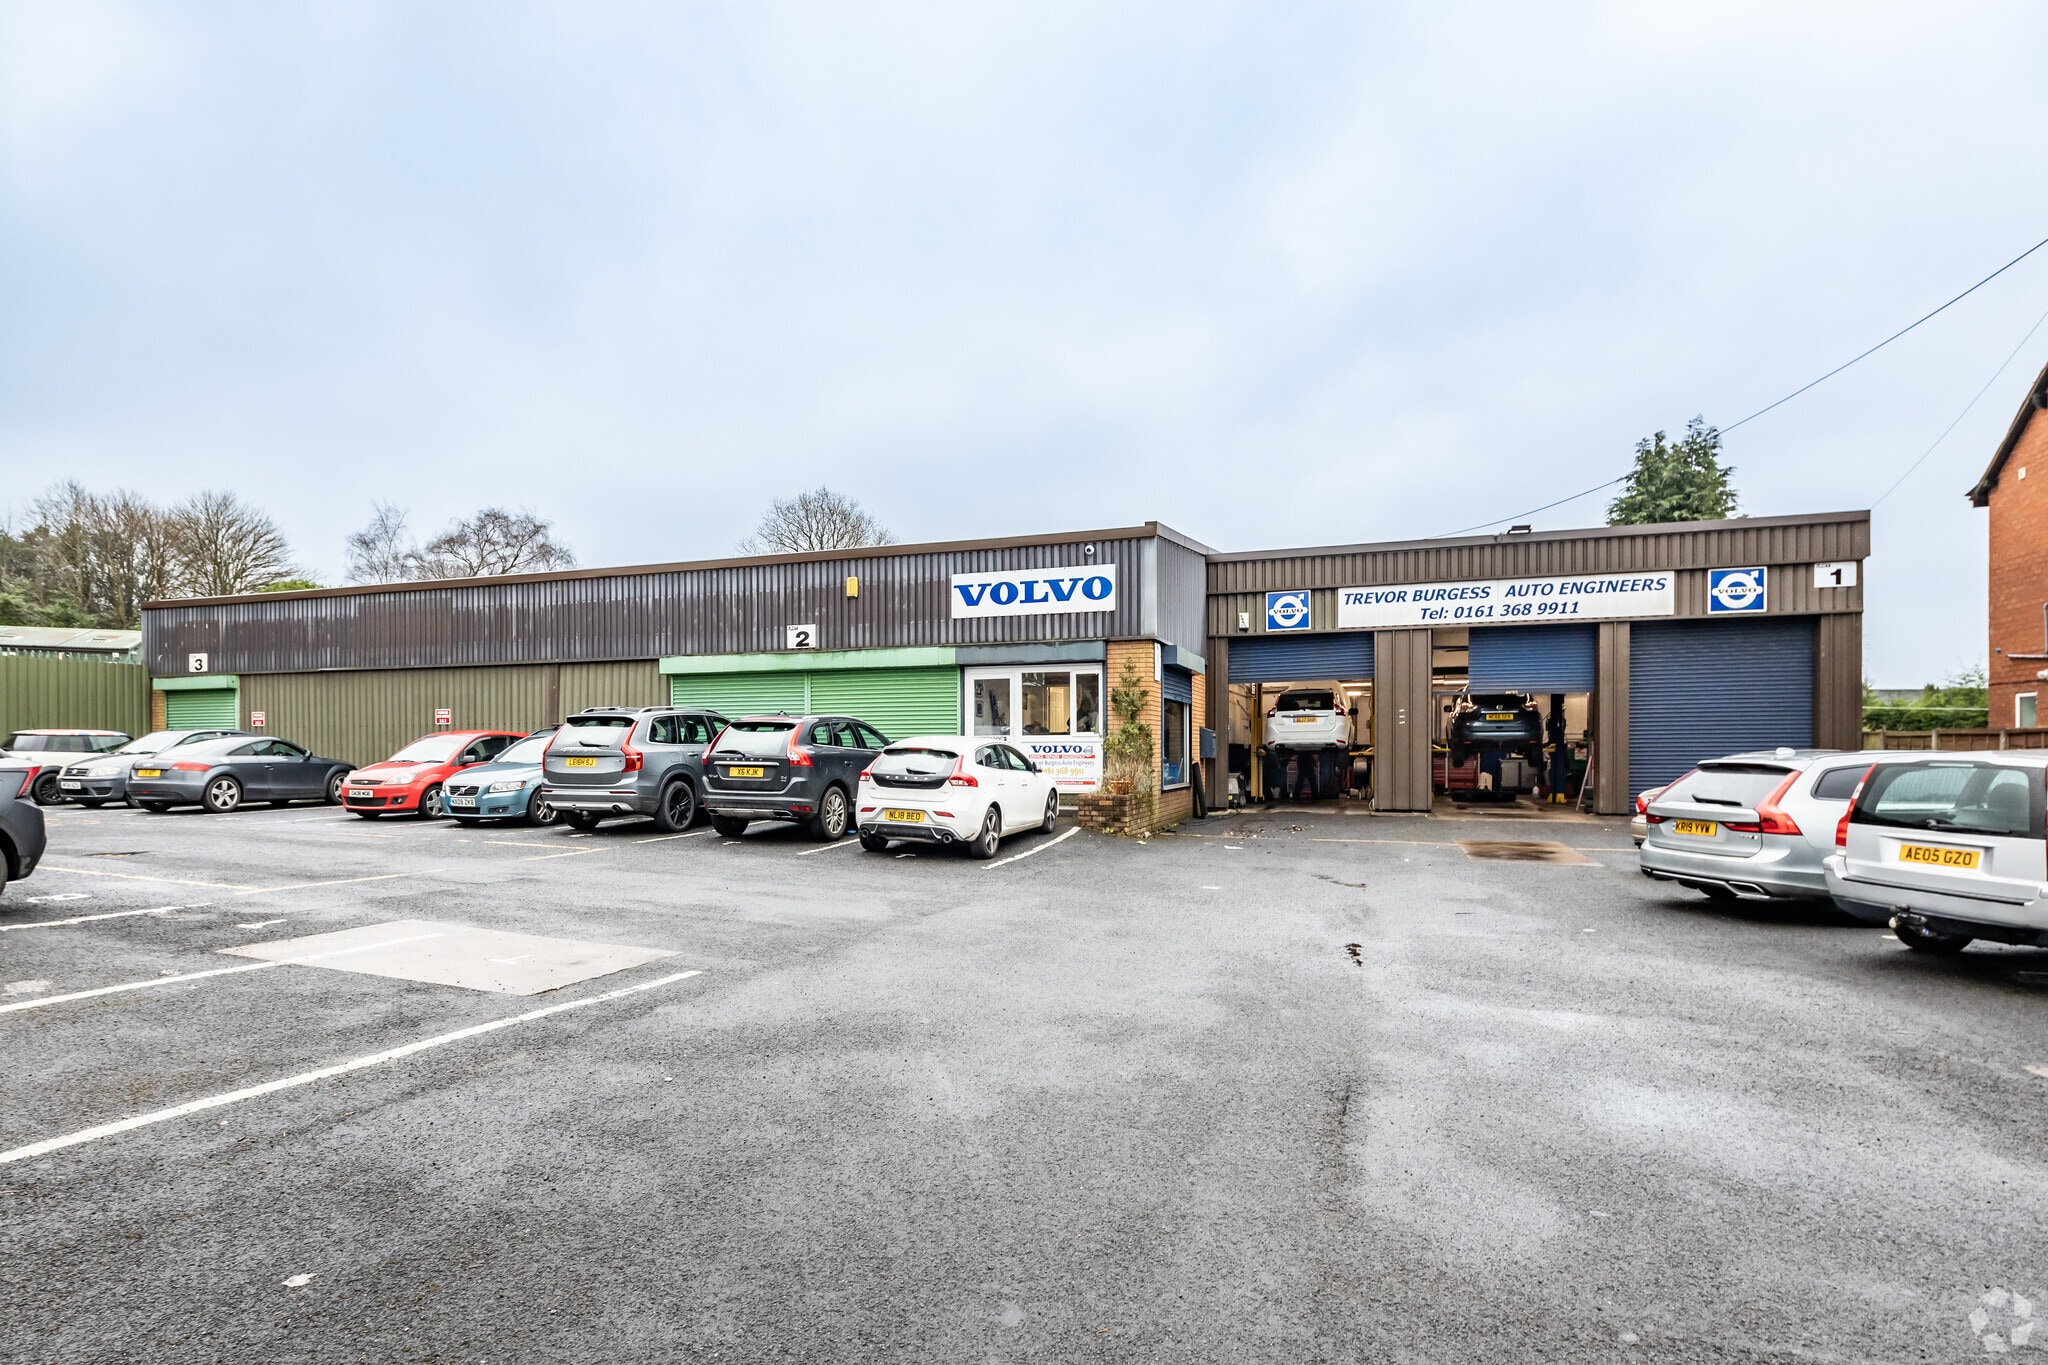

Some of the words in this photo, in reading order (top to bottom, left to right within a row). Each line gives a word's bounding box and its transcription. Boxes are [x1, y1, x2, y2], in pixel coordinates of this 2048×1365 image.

[1830, 568, 1842, 585] 1
[954, 576, 1113, 607] VOLVO
[1344, 590, 1408, 605] TREVOR
[1412, 586, 1491, 602] BURGESS
[1504, 583, 1554, 598] AUTO
[1558, 578, 1668, 595] ENGINEERS
[1420, 607, 1449, 620] Tel:
[1453, 605, 1494, 619] 0161
[1500, 603, 1532, 617] 368
[1537, 601, 1579, 615] 9911
[796, 631, 810, 647] 2
[194, 658, 203, 671] 3
[1030, 745, 1083, 753] VOLVO
[1056, 767, 1069, 775] 368
[1675, 822, 1693, 832] KR19
[1695, 824, 1711, 834] YVW
[1905, 847, 1940, 862] AE05
[1943, 850, 1973, 866] GZO
